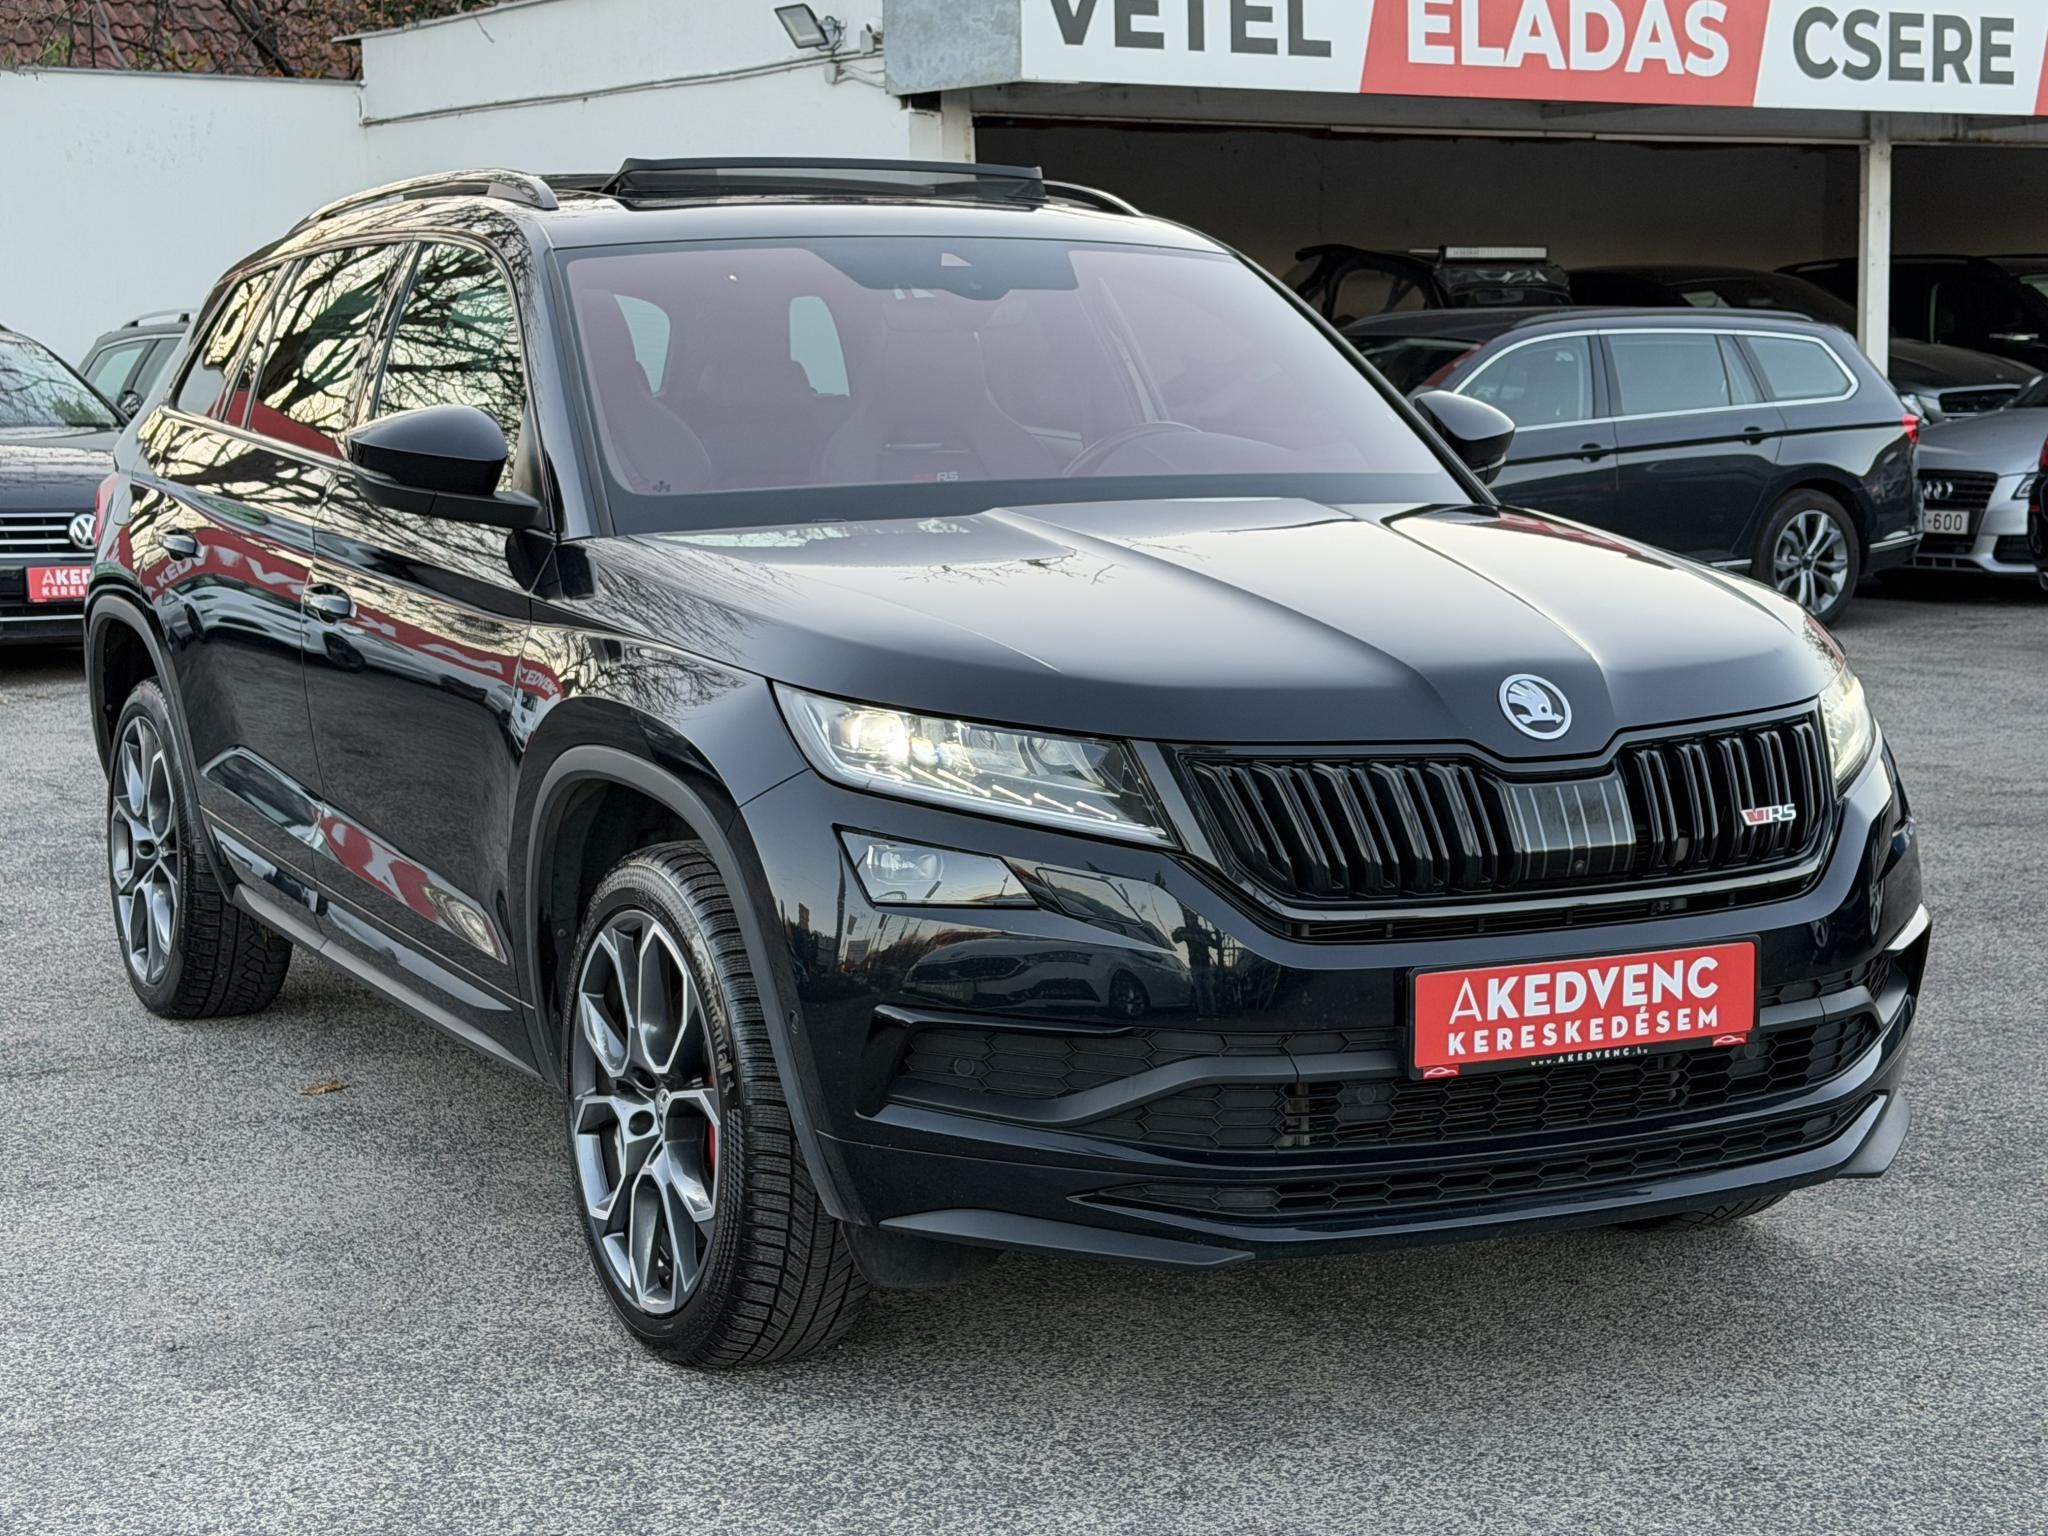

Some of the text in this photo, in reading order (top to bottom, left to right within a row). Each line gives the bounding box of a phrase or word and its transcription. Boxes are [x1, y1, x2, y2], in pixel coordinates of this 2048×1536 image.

[1793, 6, 2015, 85] CSERE
[1923, 513, 1963, 531] -600
[1449, 956, 1720, 1025] AKEDVENC
[1447, 1005, 1719, 1057] KERESKEDÉSEM
